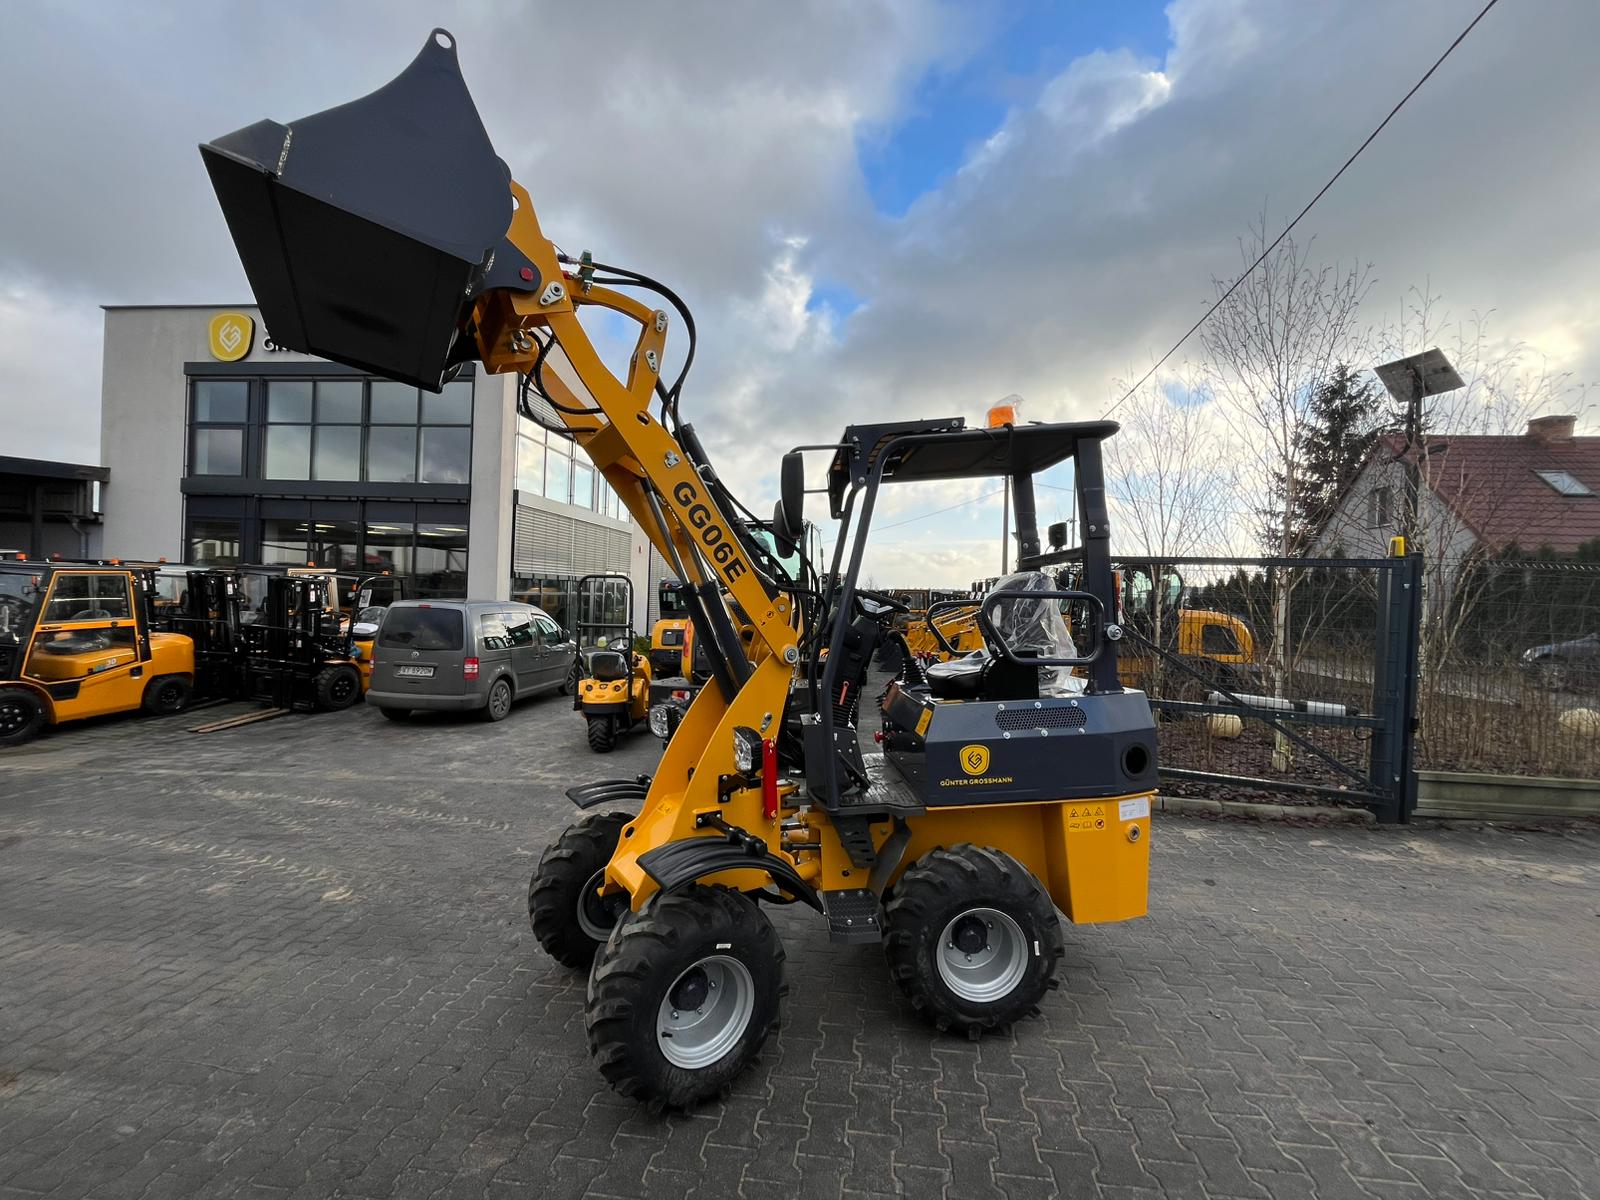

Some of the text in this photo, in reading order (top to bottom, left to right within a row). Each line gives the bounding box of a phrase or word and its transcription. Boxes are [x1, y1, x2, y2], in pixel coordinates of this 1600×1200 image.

[673, 482, 747, 584] GG06E
[939, 776, 1013, 787] GÜNTER GROSSMANN
